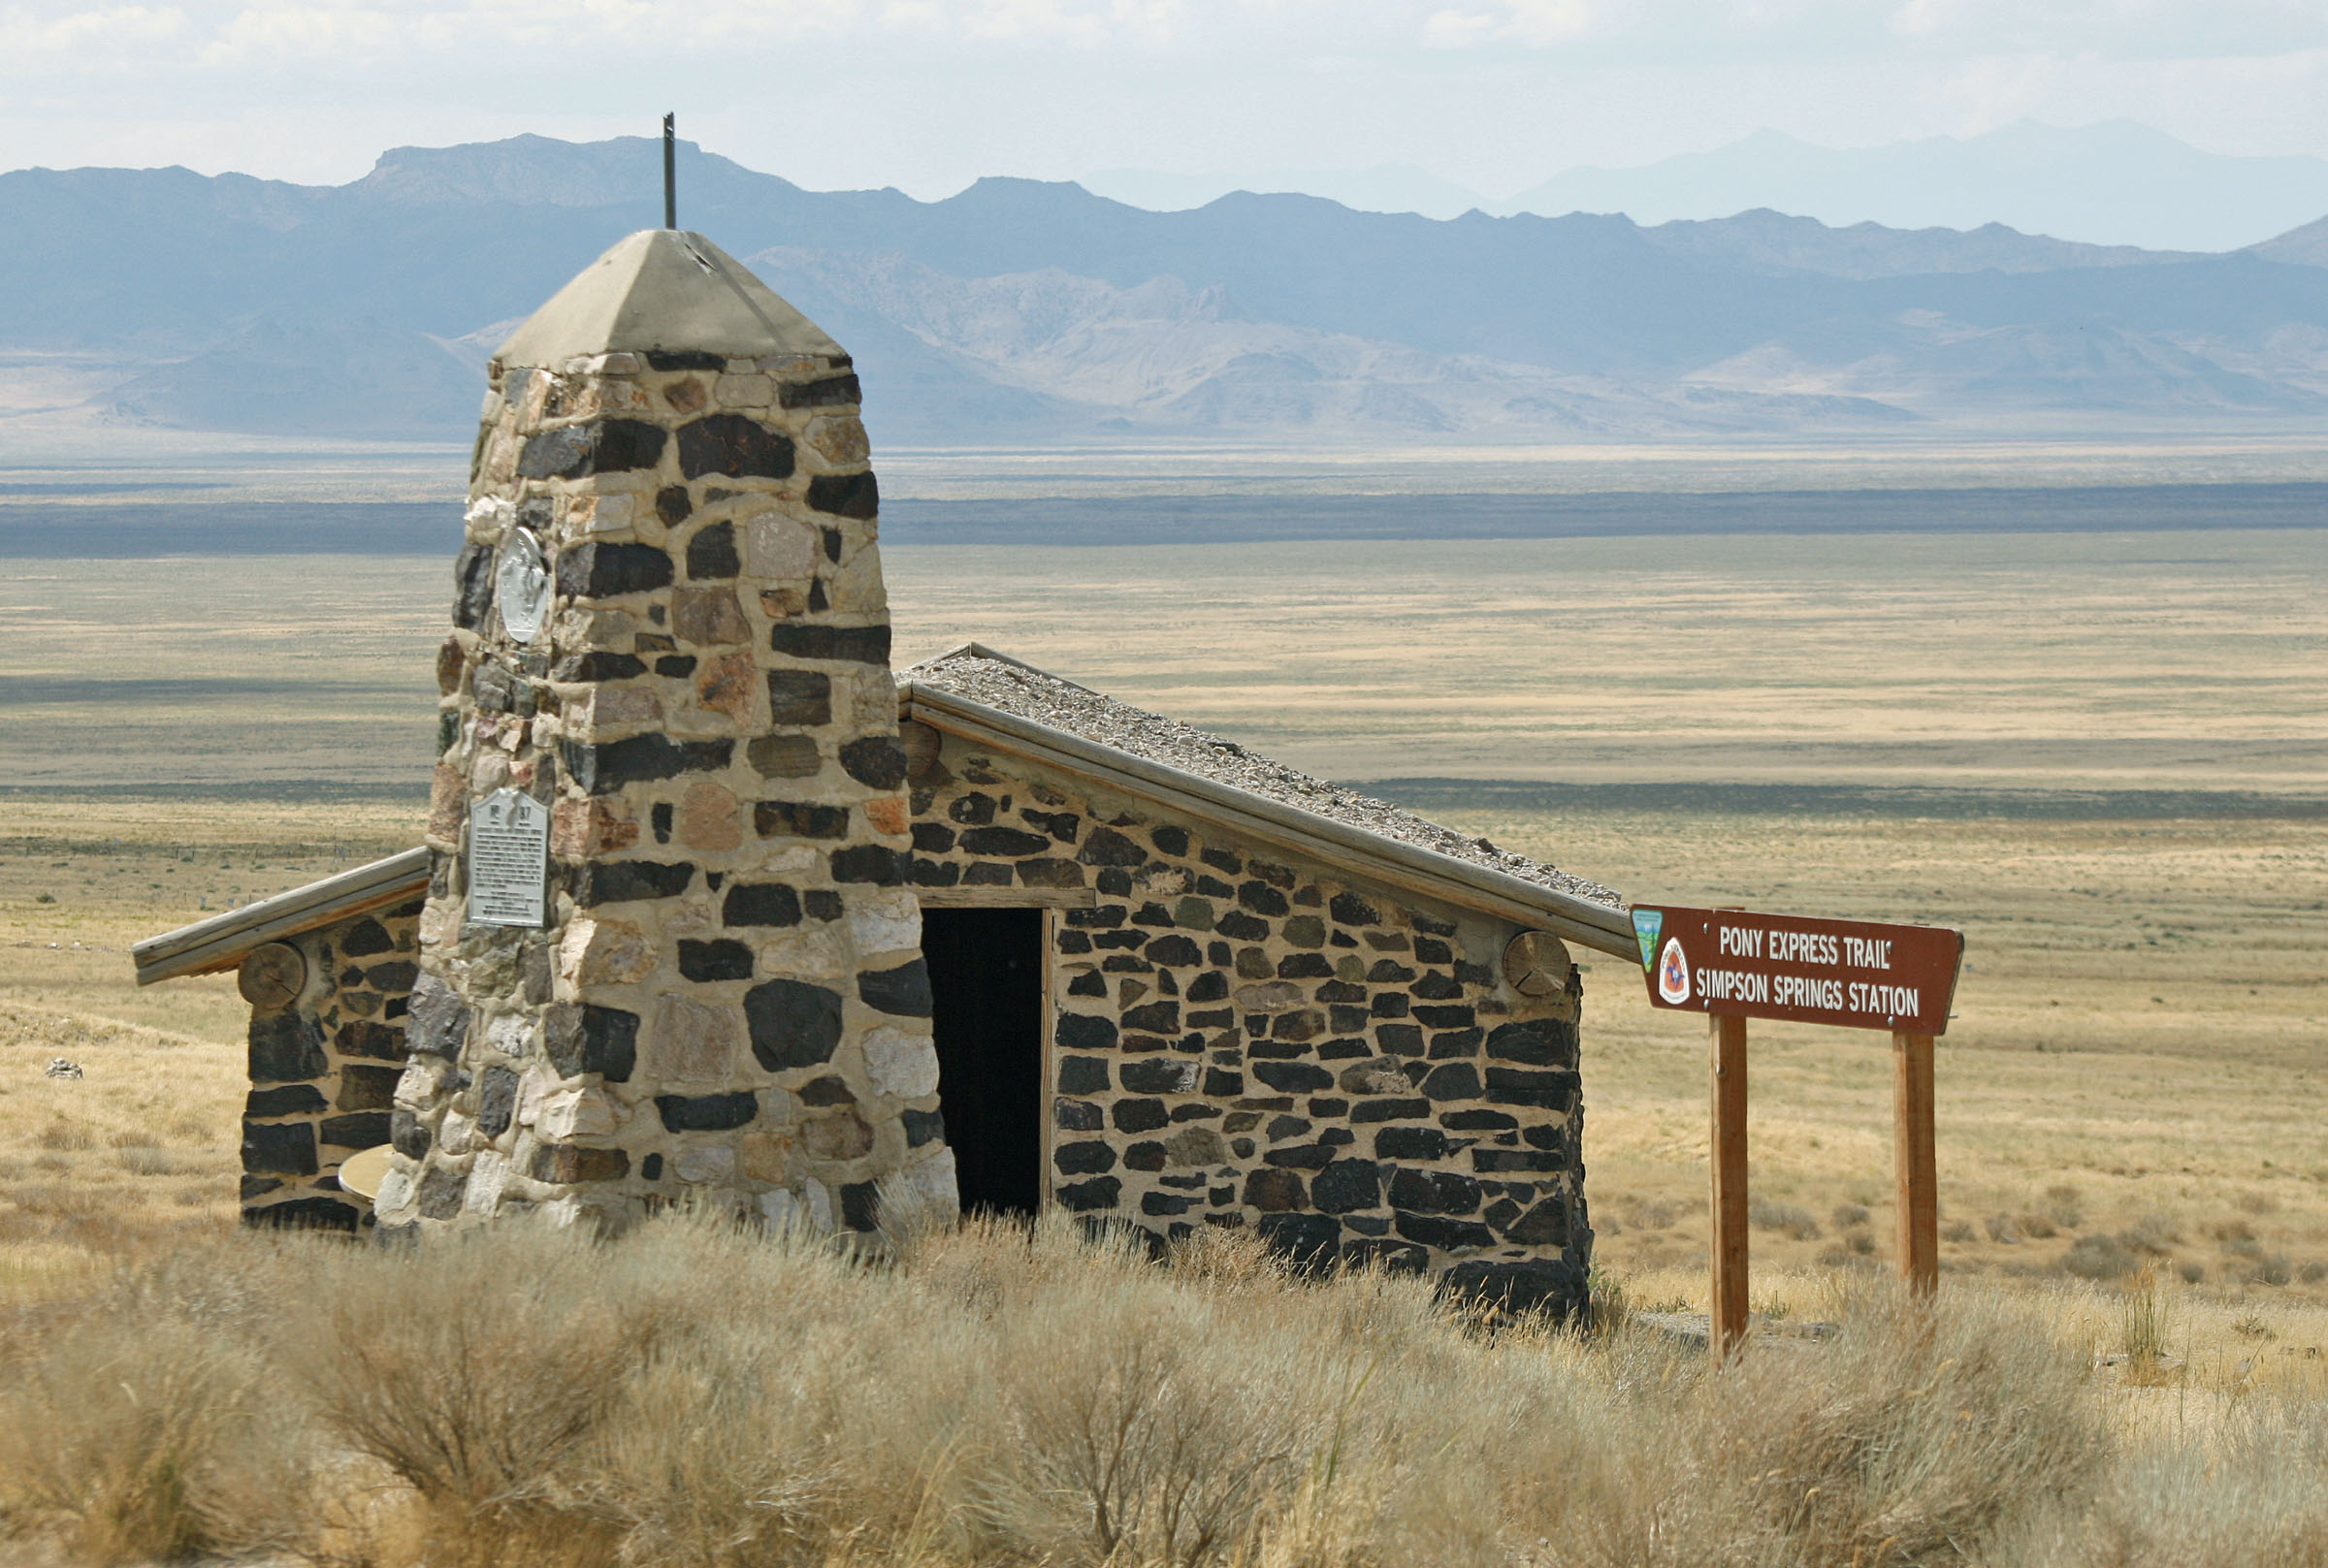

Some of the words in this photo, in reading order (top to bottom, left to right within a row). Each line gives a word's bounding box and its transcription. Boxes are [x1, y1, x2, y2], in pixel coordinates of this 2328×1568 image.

[1720, 926, 1763, 958] PONY
[1768, 931, 1838, 965] EXPRESS
[1843, 937, 1891, 970] TRAIL
[1697, 968, 1768, 1004] SIMPSON
[1774, 975, 1843, 1010] SPRINGS
[1849, 982, 1919, 1017] STATION
